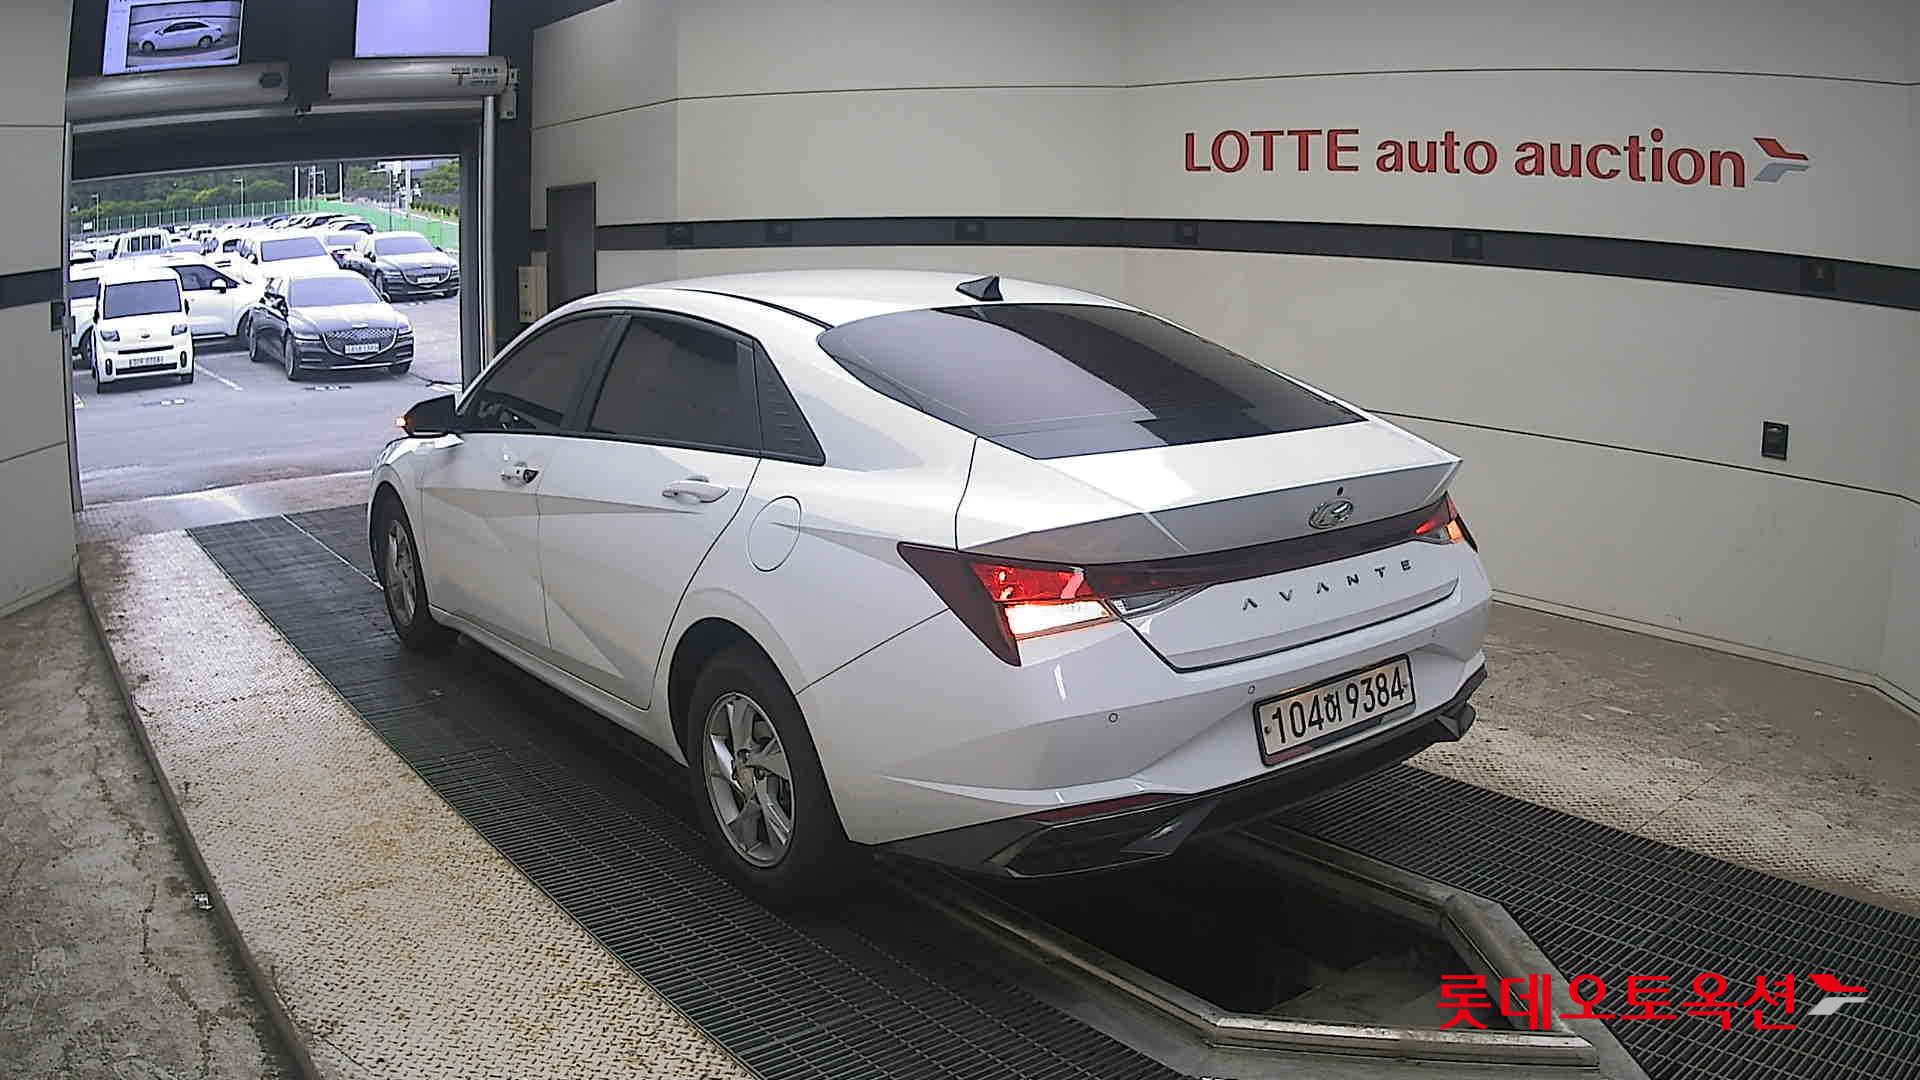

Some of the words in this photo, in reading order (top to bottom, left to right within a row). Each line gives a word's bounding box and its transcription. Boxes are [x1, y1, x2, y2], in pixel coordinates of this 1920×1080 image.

[1185, 129, 1359, 173] LOTTE
[1376, 131, 1498, 175] auto
[1515, 128, 1745, 188] auction
[1242, 560, 1412, 611] AVANTE
[1271, 691, 1343, 744] 104허
[1345, 666, 1405, 718] 9384
